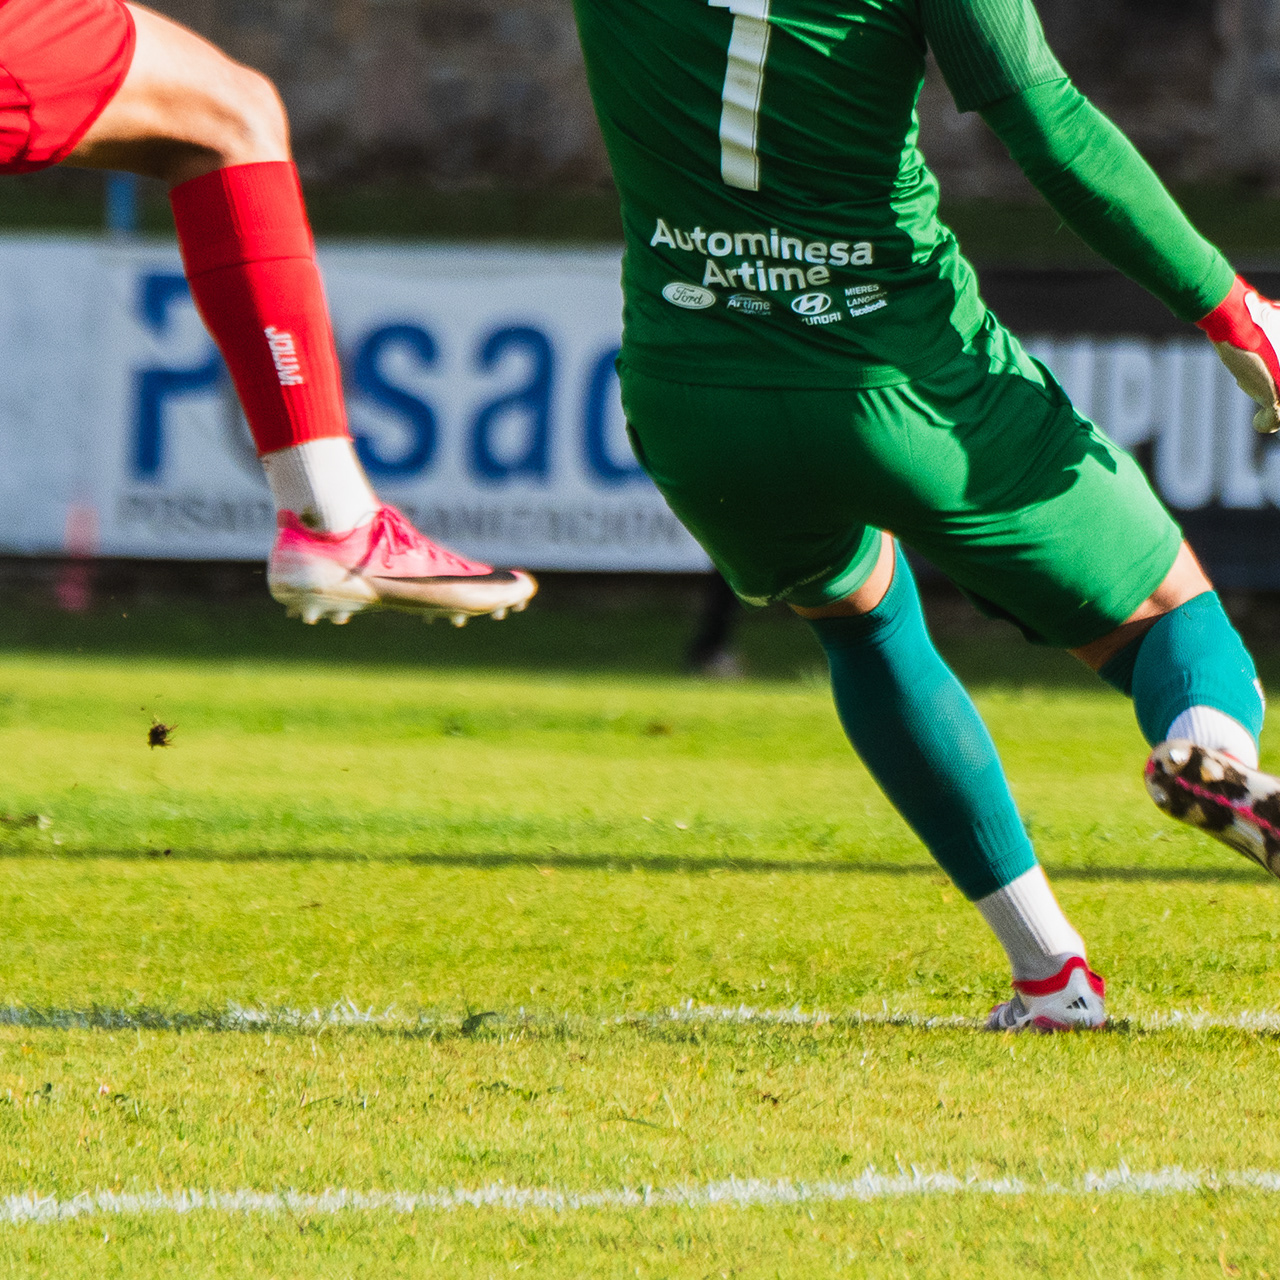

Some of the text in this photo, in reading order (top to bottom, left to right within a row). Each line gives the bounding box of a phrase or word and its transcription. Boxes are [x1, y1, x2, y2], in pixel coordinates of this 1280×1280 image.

[650, 218, 874, 267] Autominesa
[702, 259, 831, 292] Artime
[672, 286, 705, 306] Ford
[844, 283, 880, 297] MIERES
[726, 297, 771, 311] Artime
[849, 299, 888, 318] facebook
